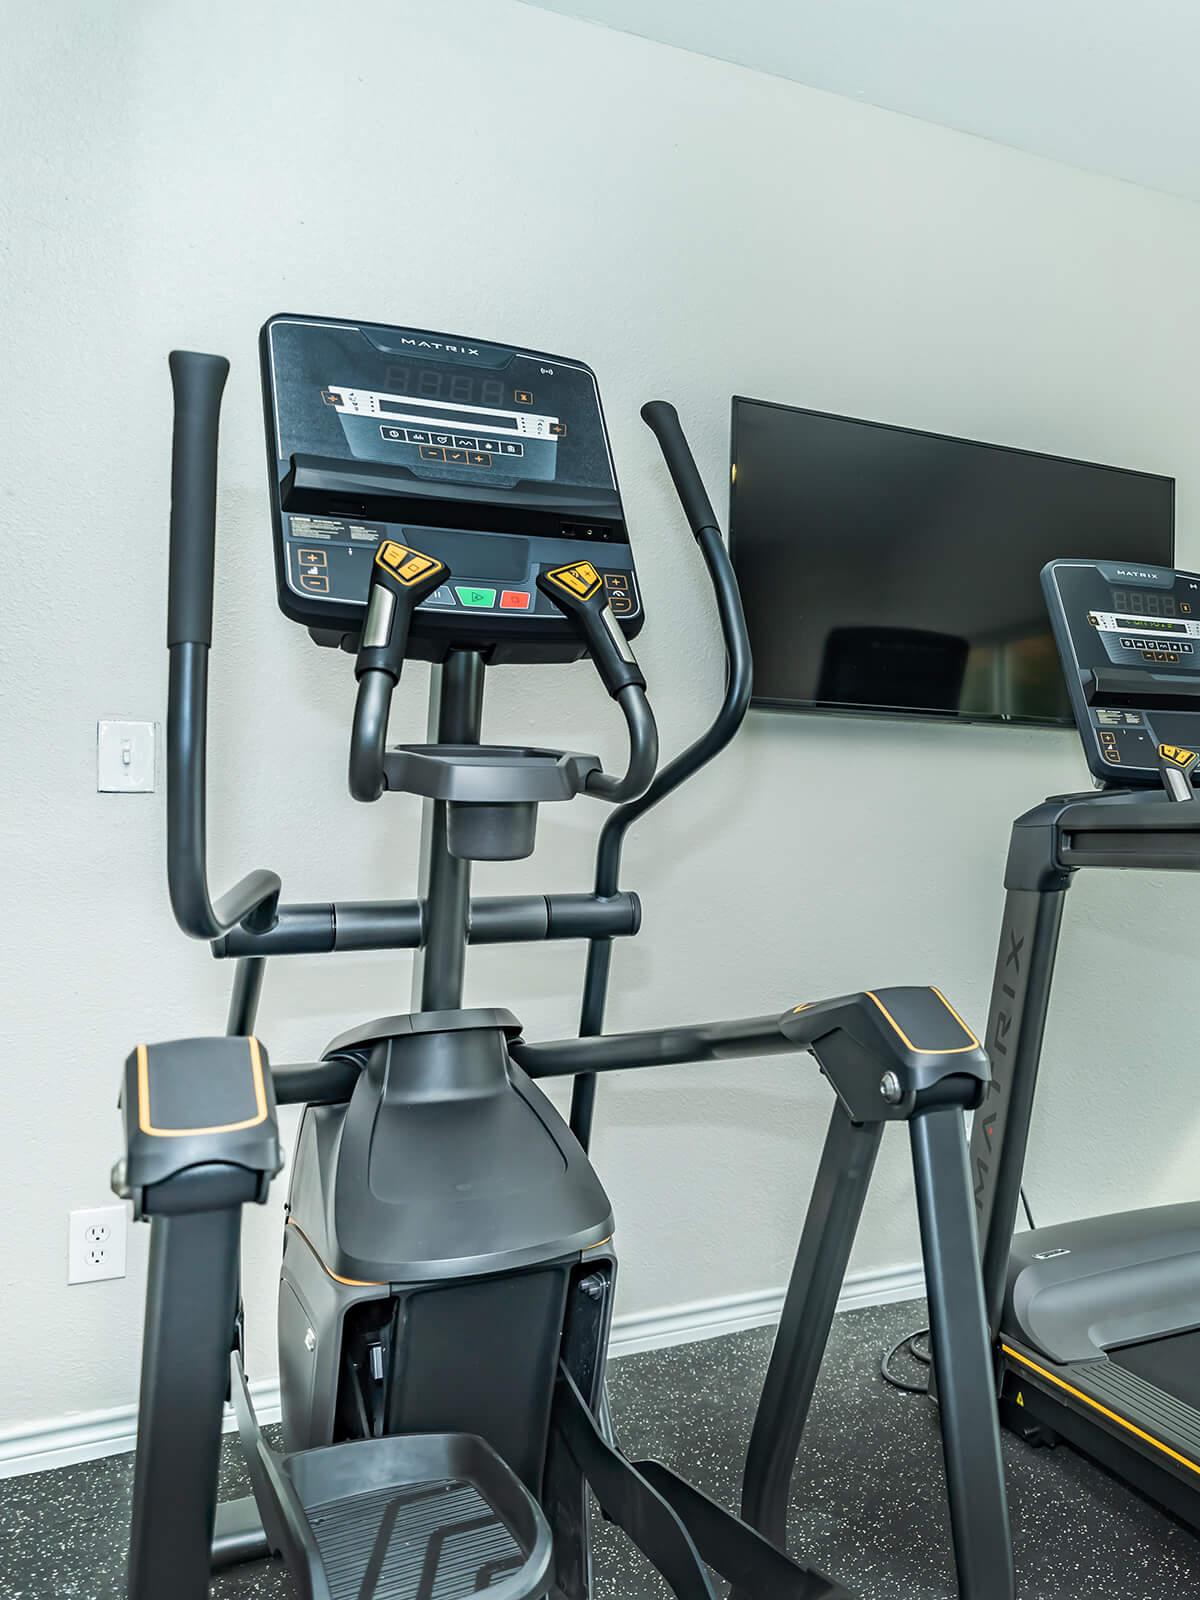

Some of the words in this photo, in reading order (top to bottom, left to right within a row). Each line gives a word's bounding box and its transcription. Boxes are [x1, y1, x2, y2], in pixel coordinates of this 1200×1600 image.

[400, 337, 480, 357] MATRIX
[1116, 569, 1159, 580] MATRIX
[975, 932, 1025, 1211] MATRIX
